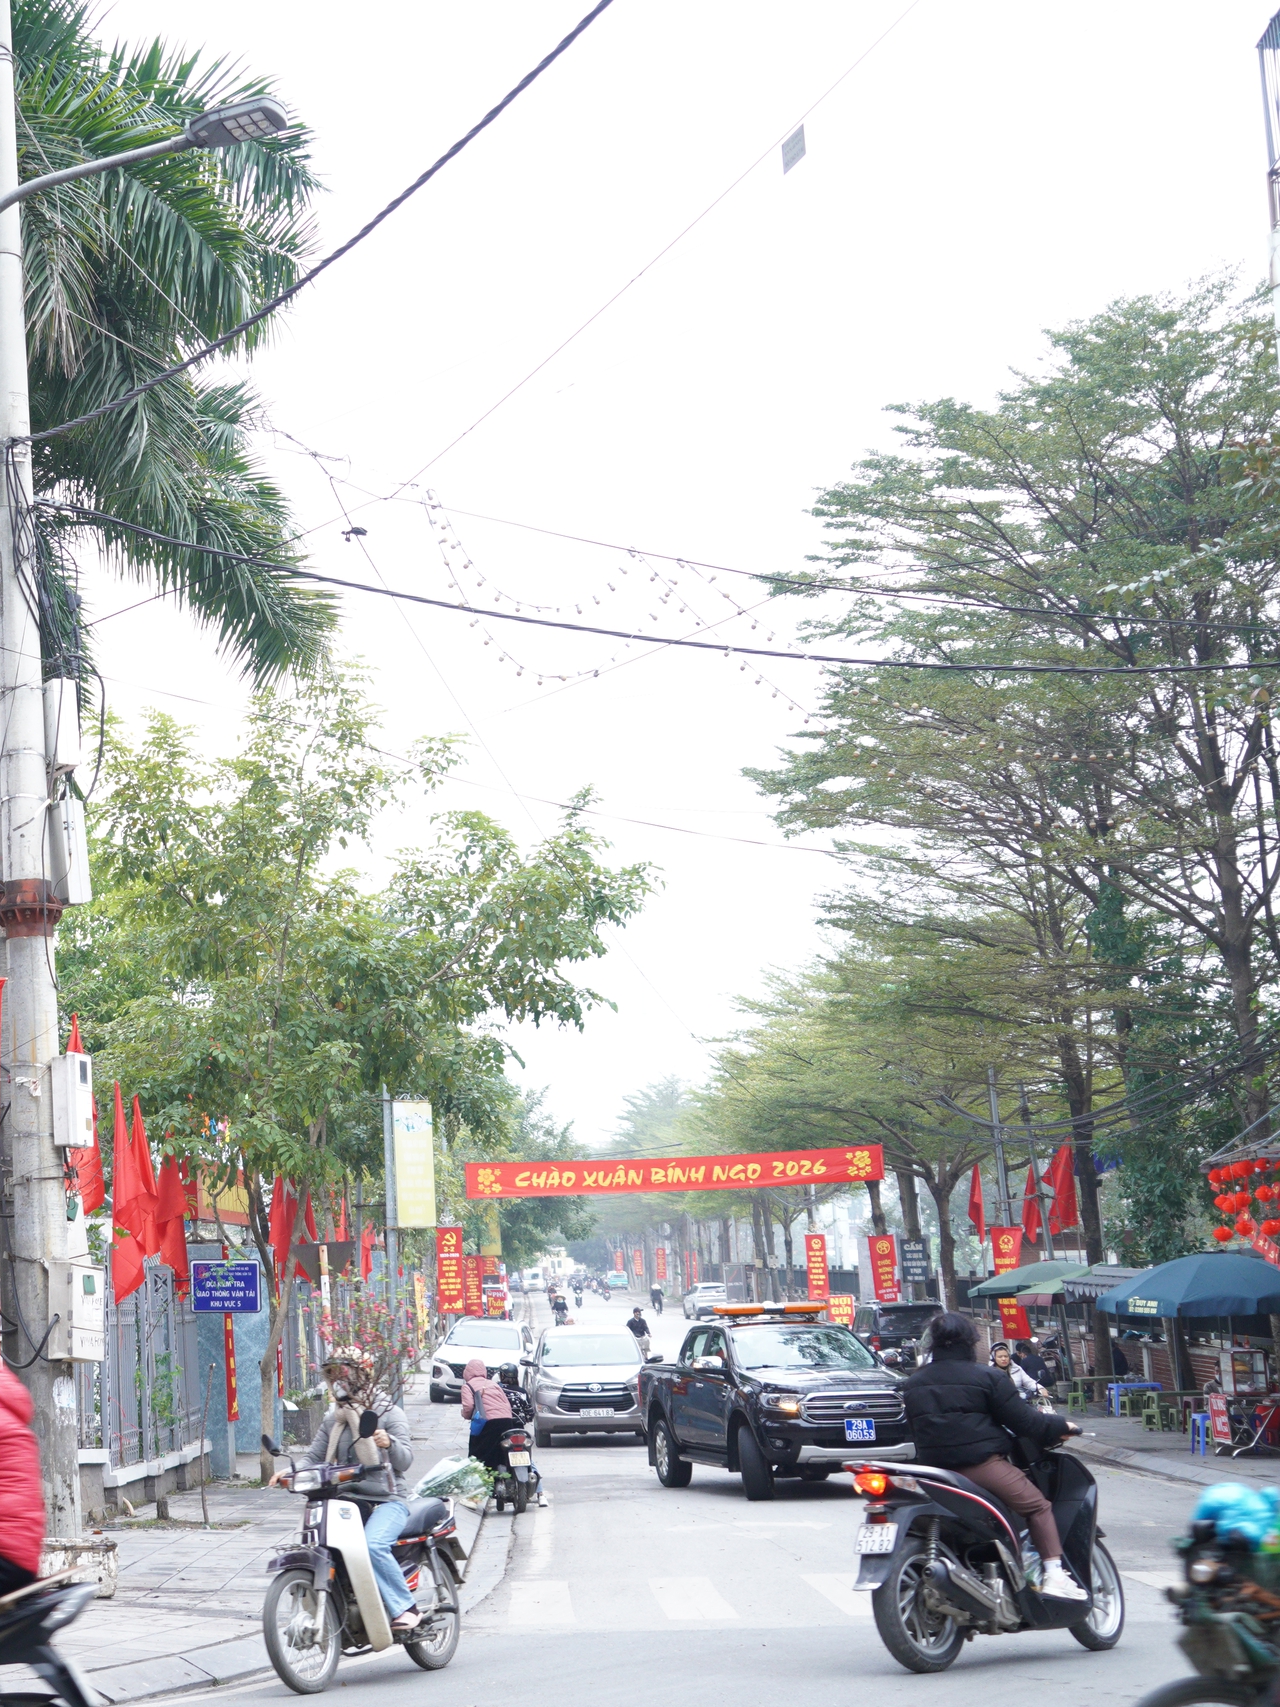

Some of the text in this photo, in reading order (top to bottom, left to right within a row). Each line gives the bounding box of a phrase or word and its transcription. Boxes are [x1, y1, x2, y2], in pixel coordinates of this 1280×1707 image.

[514, 1159, 827, 1189] CHÀO XUÂN BÍNH NGỌ 2026
[851, 1420, 868, 1430] 29A
